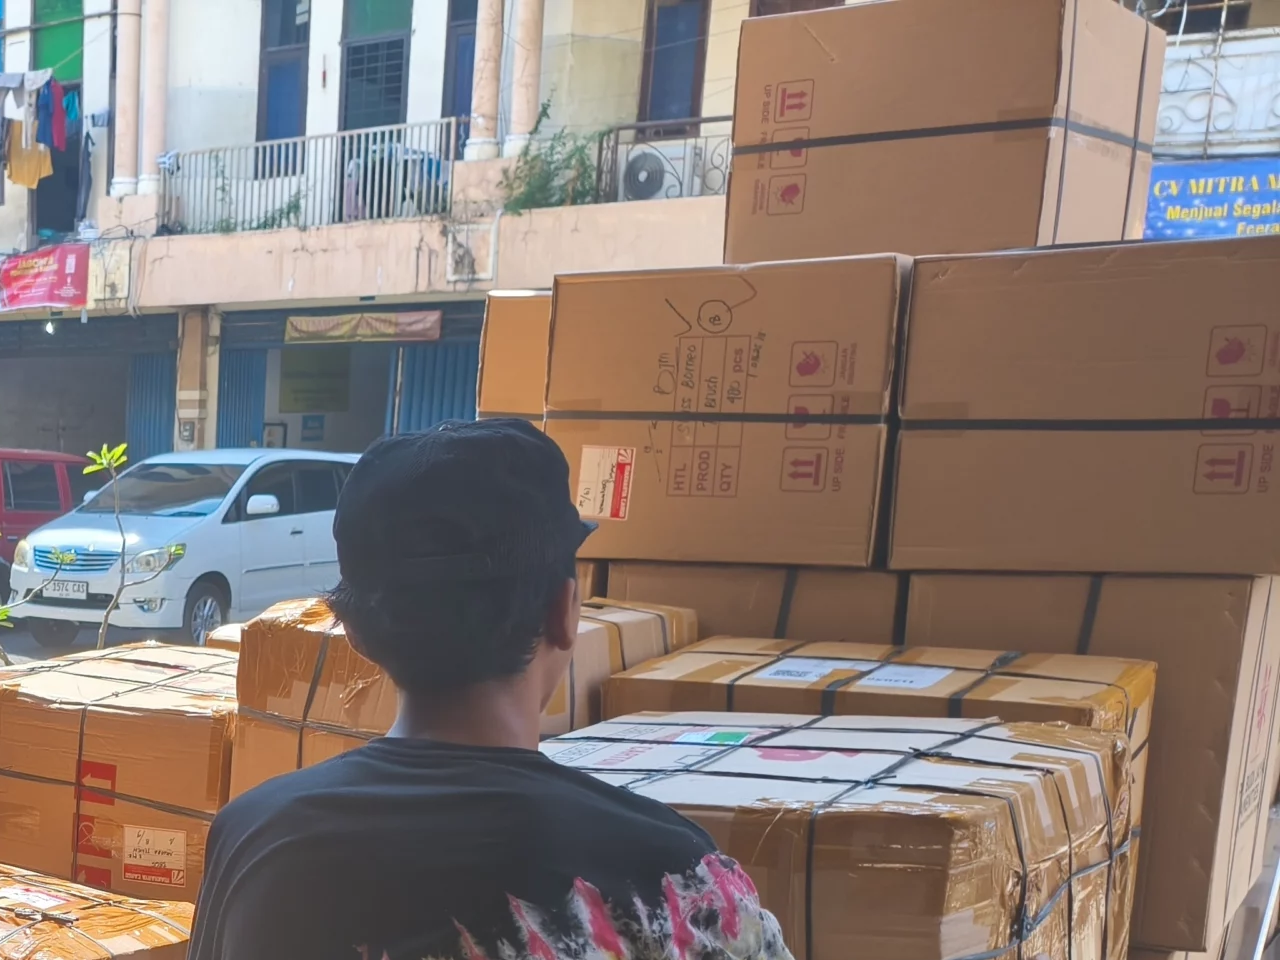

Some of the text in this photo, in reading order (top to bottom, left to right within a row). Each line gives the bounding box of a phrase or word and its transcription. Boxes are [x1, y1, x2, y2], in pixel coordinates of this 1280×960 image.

[761, 84, 773, 124] UP SIDE
[1153, 179, 1184, 198] CV
[1188, 175, 1259, 195] MITRA
[1166, 204, 1228, 221] Menjual
[731, 348, 744, 374] pcs
[672, 463, 687, 491] HTL
[696, 450, 711, 492] PROD
[720, 462, 733, 492] QTY
[831, 448, 845, 492] UP SIDE
[1257, 444, 1273, 493] UP SIDE
